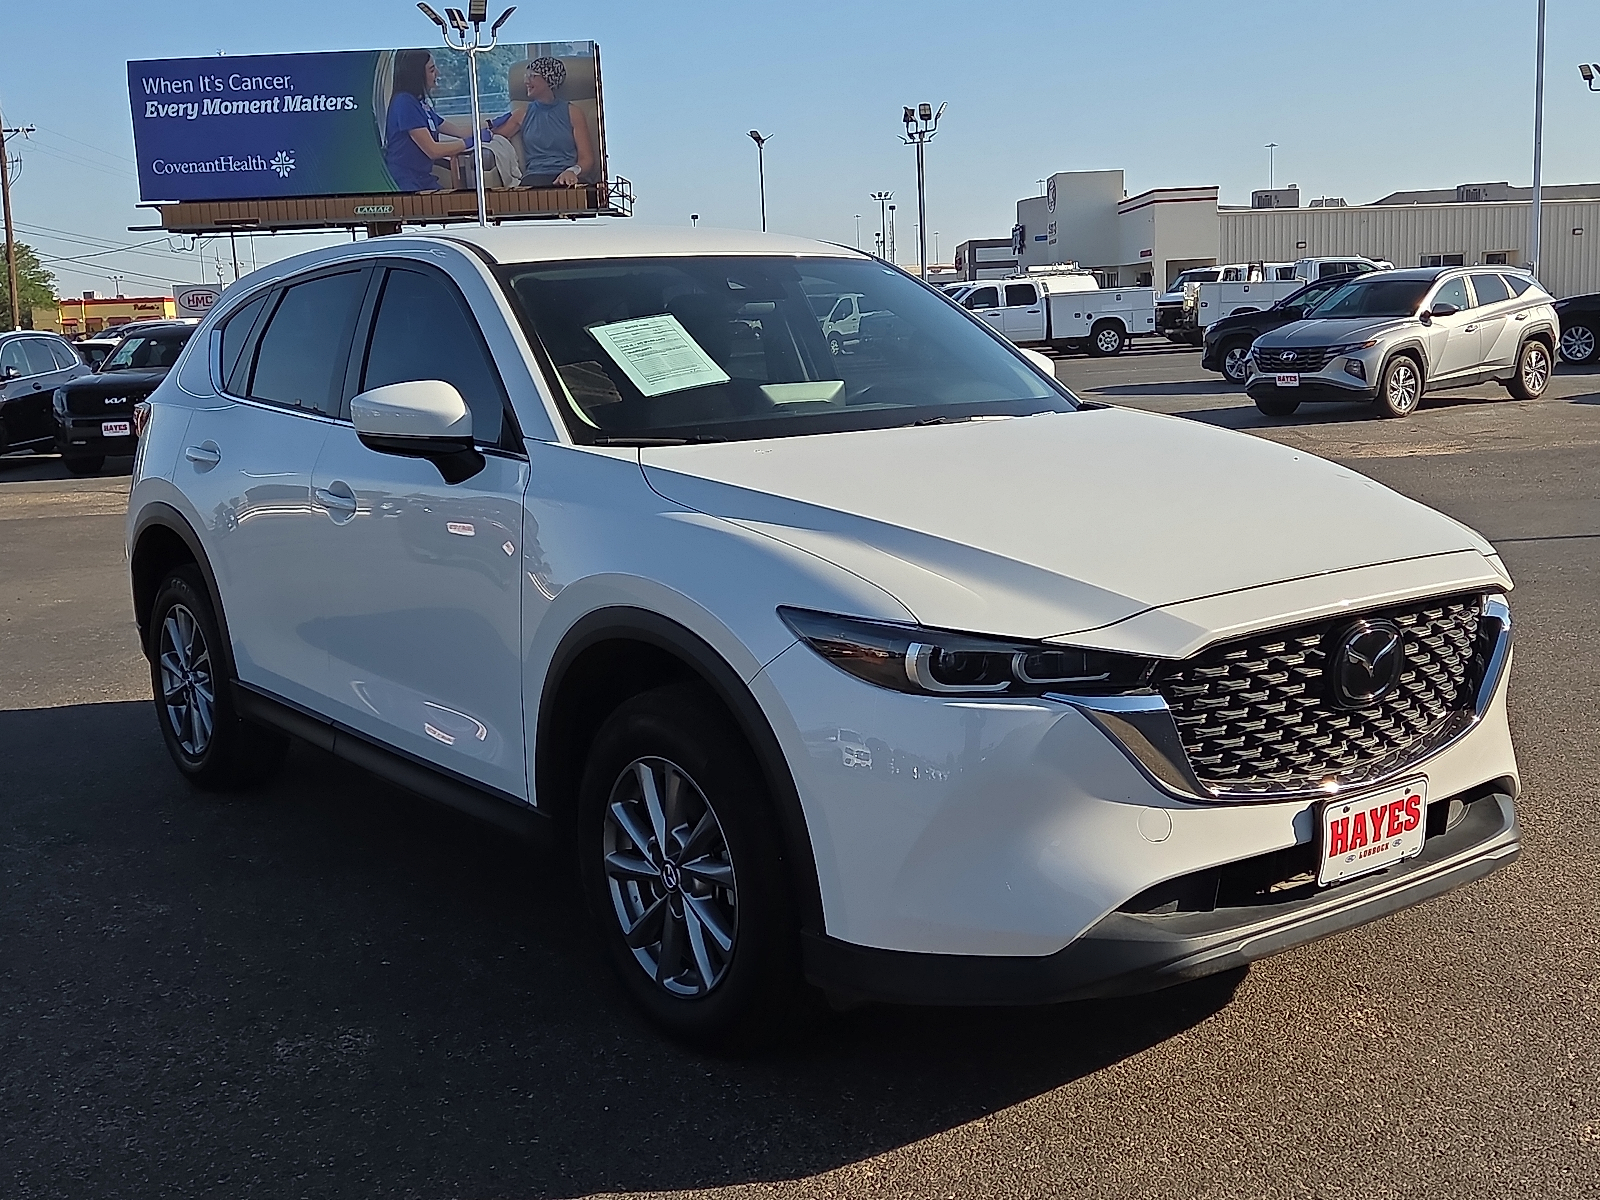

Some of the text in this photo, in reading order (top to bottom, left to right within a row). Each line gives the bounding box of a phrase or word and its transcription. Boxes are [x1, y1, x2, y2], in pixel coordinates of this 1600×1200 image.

[142, 74, 294, 95] When It's Cancer,
[145, 94, 358, 120] Every Moment Matters.
[152, 155, 267, 175] CovenantHealth
[357, 205, 390, 213] LAMAR
[188, 293, 213, 307] HMC
[1329, 794, 1421, 858] HAYES
[1358, 843, 1390, 859] LUBBOCK
